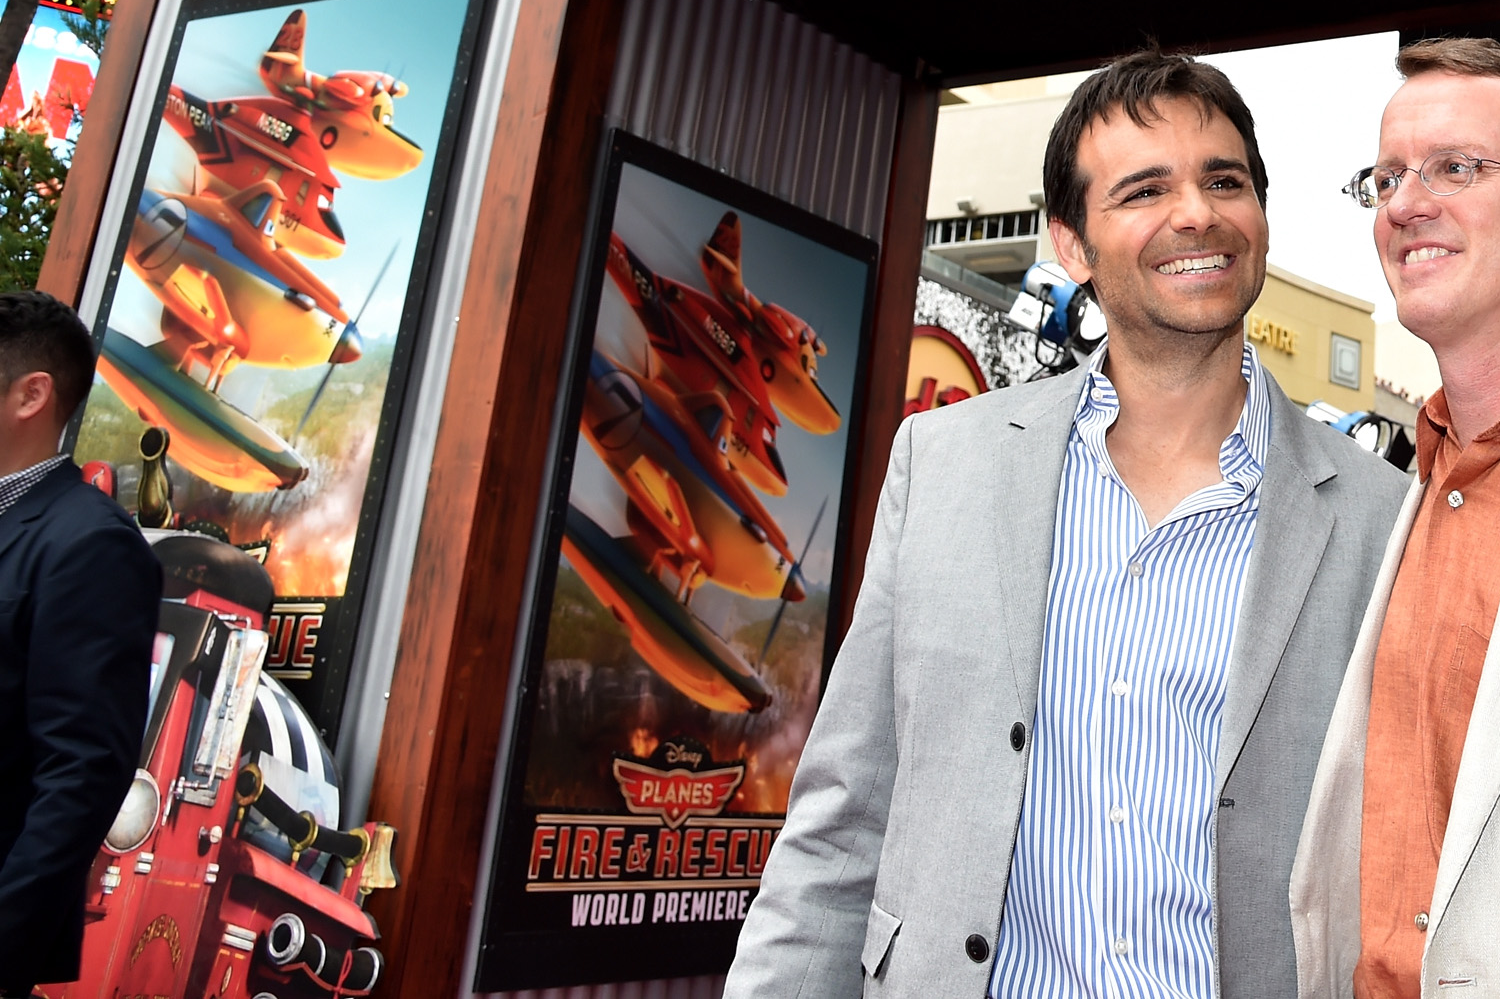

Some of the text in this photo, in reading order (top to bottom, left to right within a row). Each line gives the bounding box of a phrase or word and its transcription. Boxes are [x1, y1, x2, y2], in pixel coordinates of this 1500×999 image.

[640, 779, 714, 806] PLANES
[527, 825, 782, 880] FIRE & RESCU
[571, 890, 750, 928] WORLD PREMIERE
